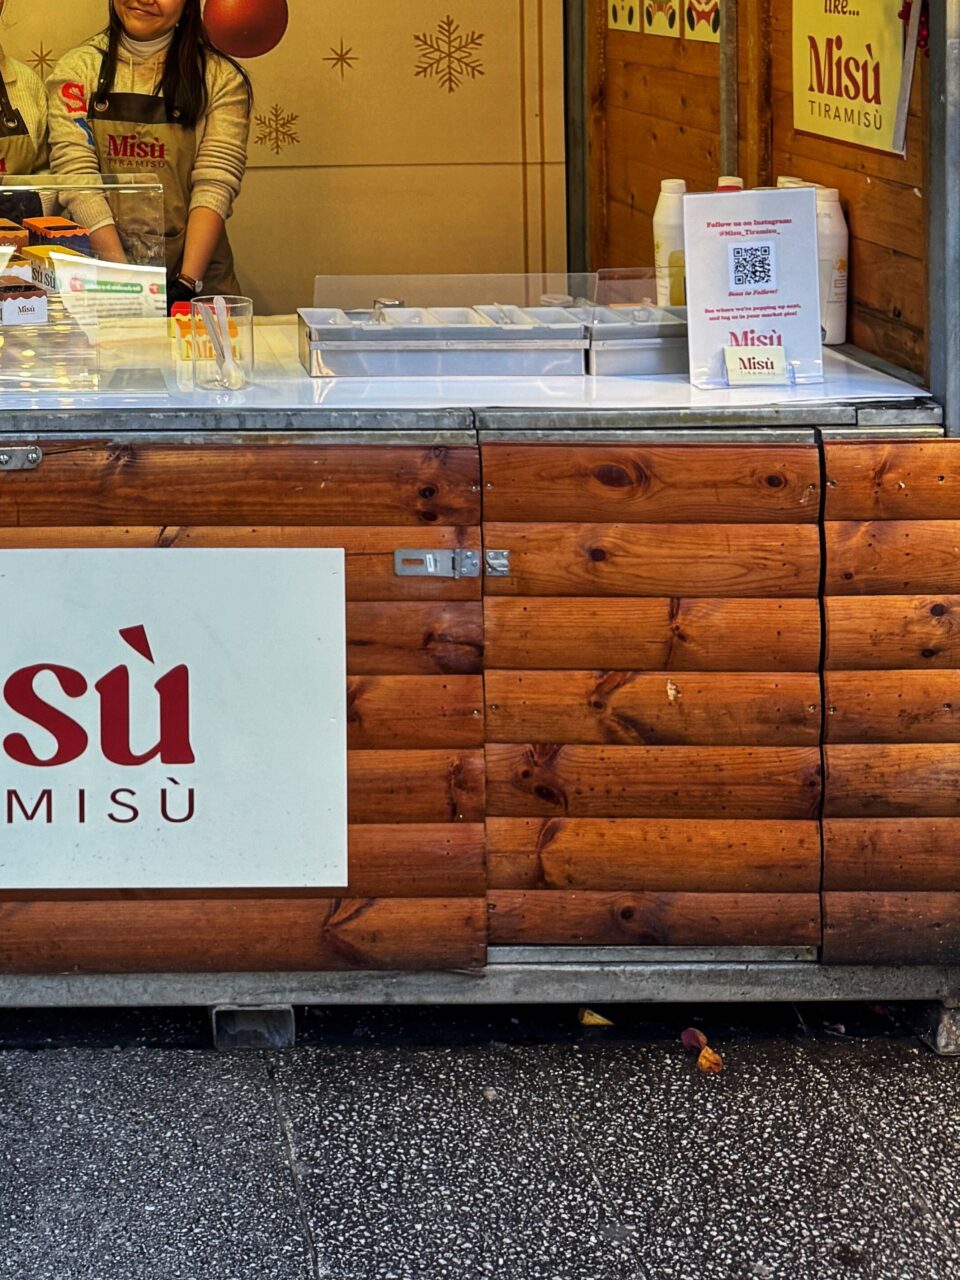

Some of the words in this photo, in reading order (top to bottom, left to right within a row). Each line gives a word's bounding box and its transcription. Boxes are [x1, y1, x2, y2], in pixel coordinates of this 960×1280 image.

[807, 34, 881, 105] Misù
[808, 99, 882, 130] TIRAMISÙ
[107, 133, 165, 159] Misù
[738, 356, 774, 370] Misù
